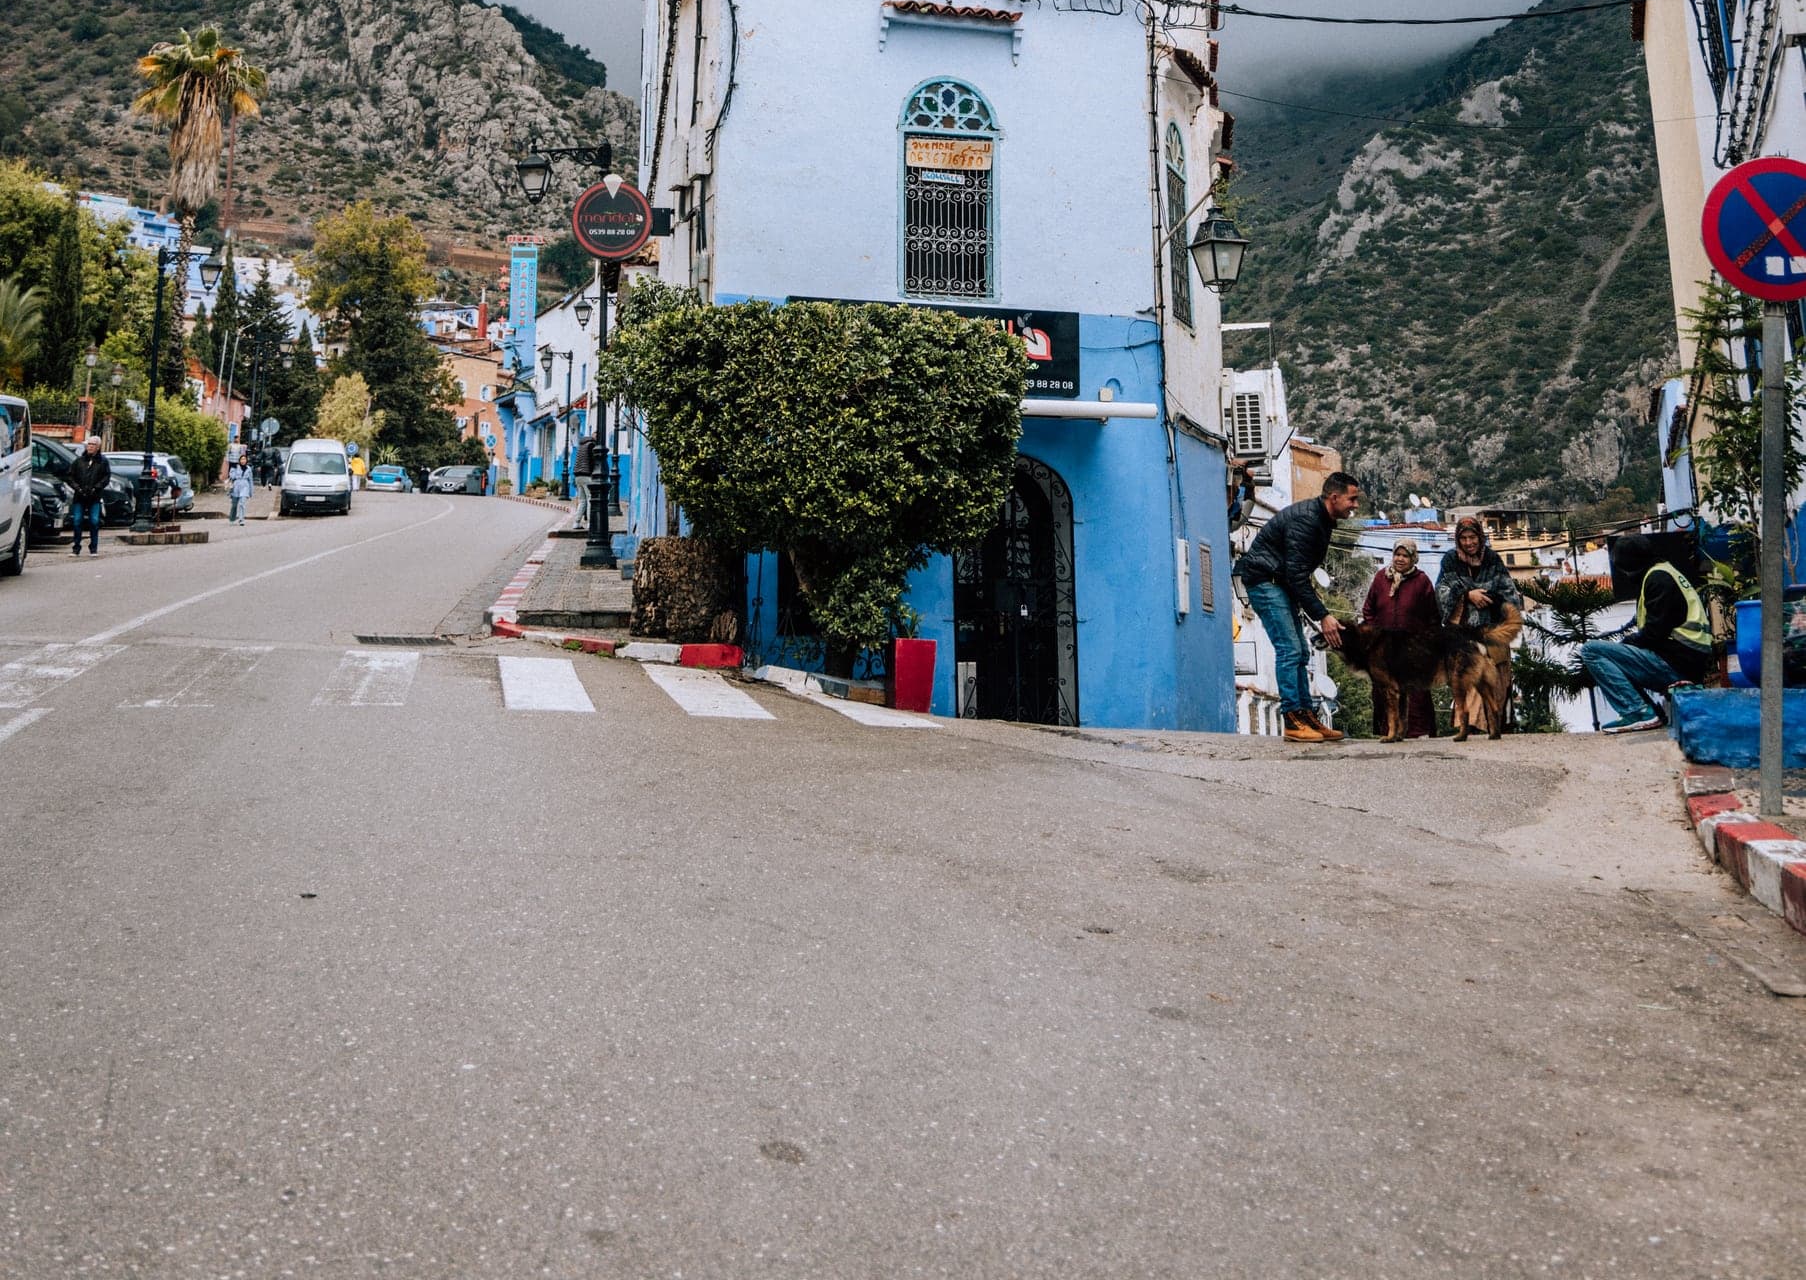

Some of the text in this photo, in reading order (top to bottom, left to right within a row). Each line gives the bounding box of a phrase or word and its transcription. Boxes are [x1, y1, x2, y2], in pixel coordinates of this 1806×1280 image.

[1037, 380, 1048, 388] 88
[1049, 380, 1060, 389] 28
[1062, 381, 1073, 390] 08
